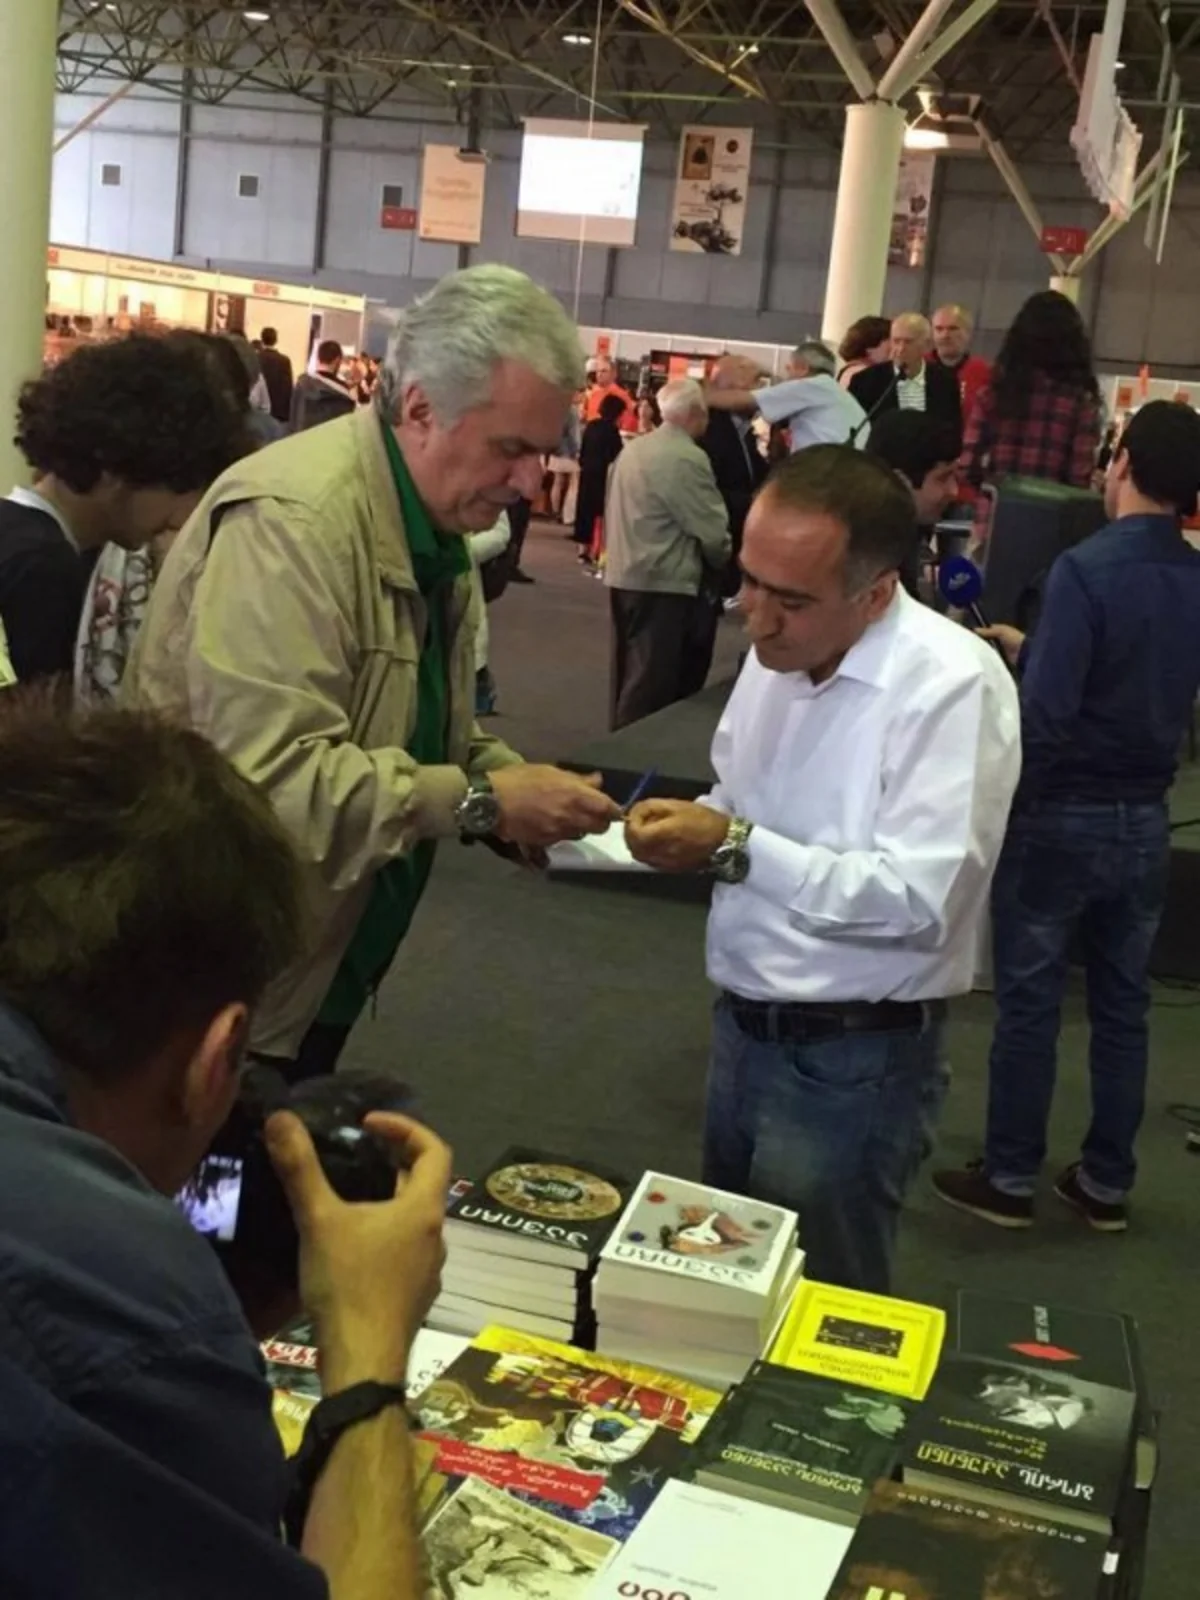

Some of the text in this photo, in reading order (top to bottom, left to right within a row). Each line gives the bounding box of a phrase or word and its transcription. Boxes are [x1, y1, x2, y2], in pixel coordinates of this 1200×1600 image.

[459, 1204, 589, 1249] პავიჩი
[614, 1244, 756, 1284] პავიჩი
[720, 1448, 792, 1477] აკუნინი
[916, 1443, 1010, 1479] აკუნინი
[795, 1468, 863, 1497] ბორის
[1019, 1467, 1096, 1502] ბორის
